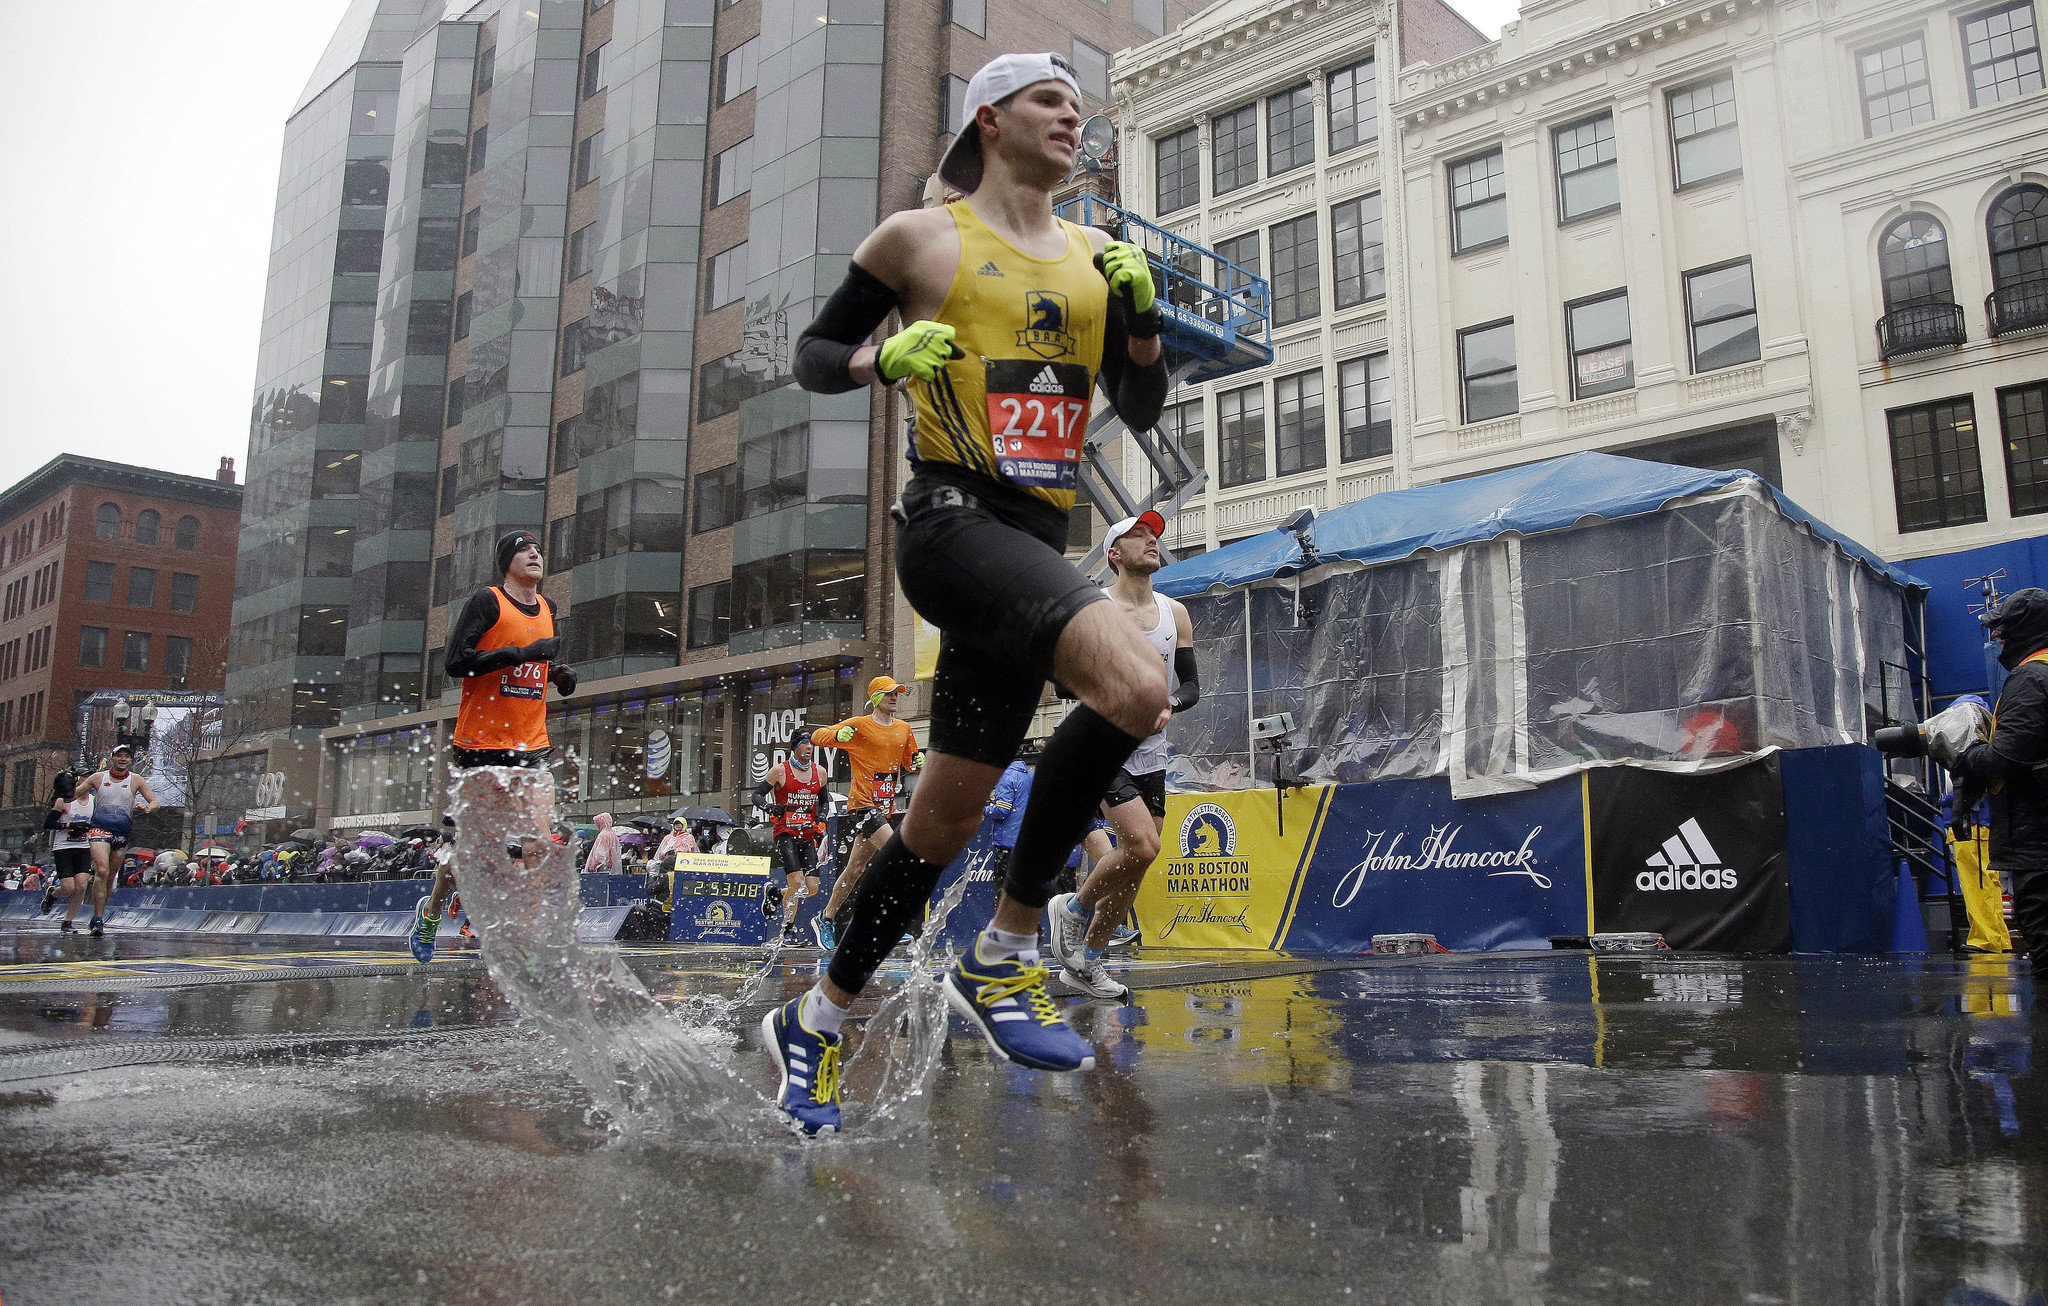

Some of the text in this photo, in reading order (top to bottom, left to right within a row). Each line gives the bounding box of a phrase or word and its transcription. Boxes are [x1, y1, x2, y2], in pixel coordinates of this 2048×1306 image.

[1582, 356, 1623, 374] LEASE
[1029, 382, 1064, 394] adidas
[1000, 397, 1083, 439] 2217
[994, 437, 1004, 454] 3
[1019, 468, 1057, 479] MARATHON
[513, 663, 541, 680] 876
[129, 694, 177, 703] #TOGETHER
[753, 708, 807, 746] RACE
[787, 798, 815, 806] MARKET
[1181, 805, 1235, 856] BOSTON ATHLETIC ASSOCIATION
[1167, 861, 1249, 876] 2018 BOSTON
[1332, 821, 1552, 908] John Hancock
[1167, 877, 1249, 893] MARATHON
[1635, 863, 1738, 891] adidas
[693, 881, 758, 898] 2:53:08
[695, 919, 714, 927] BOSTON
[1159, 901, 1253, 940] John Hancock
